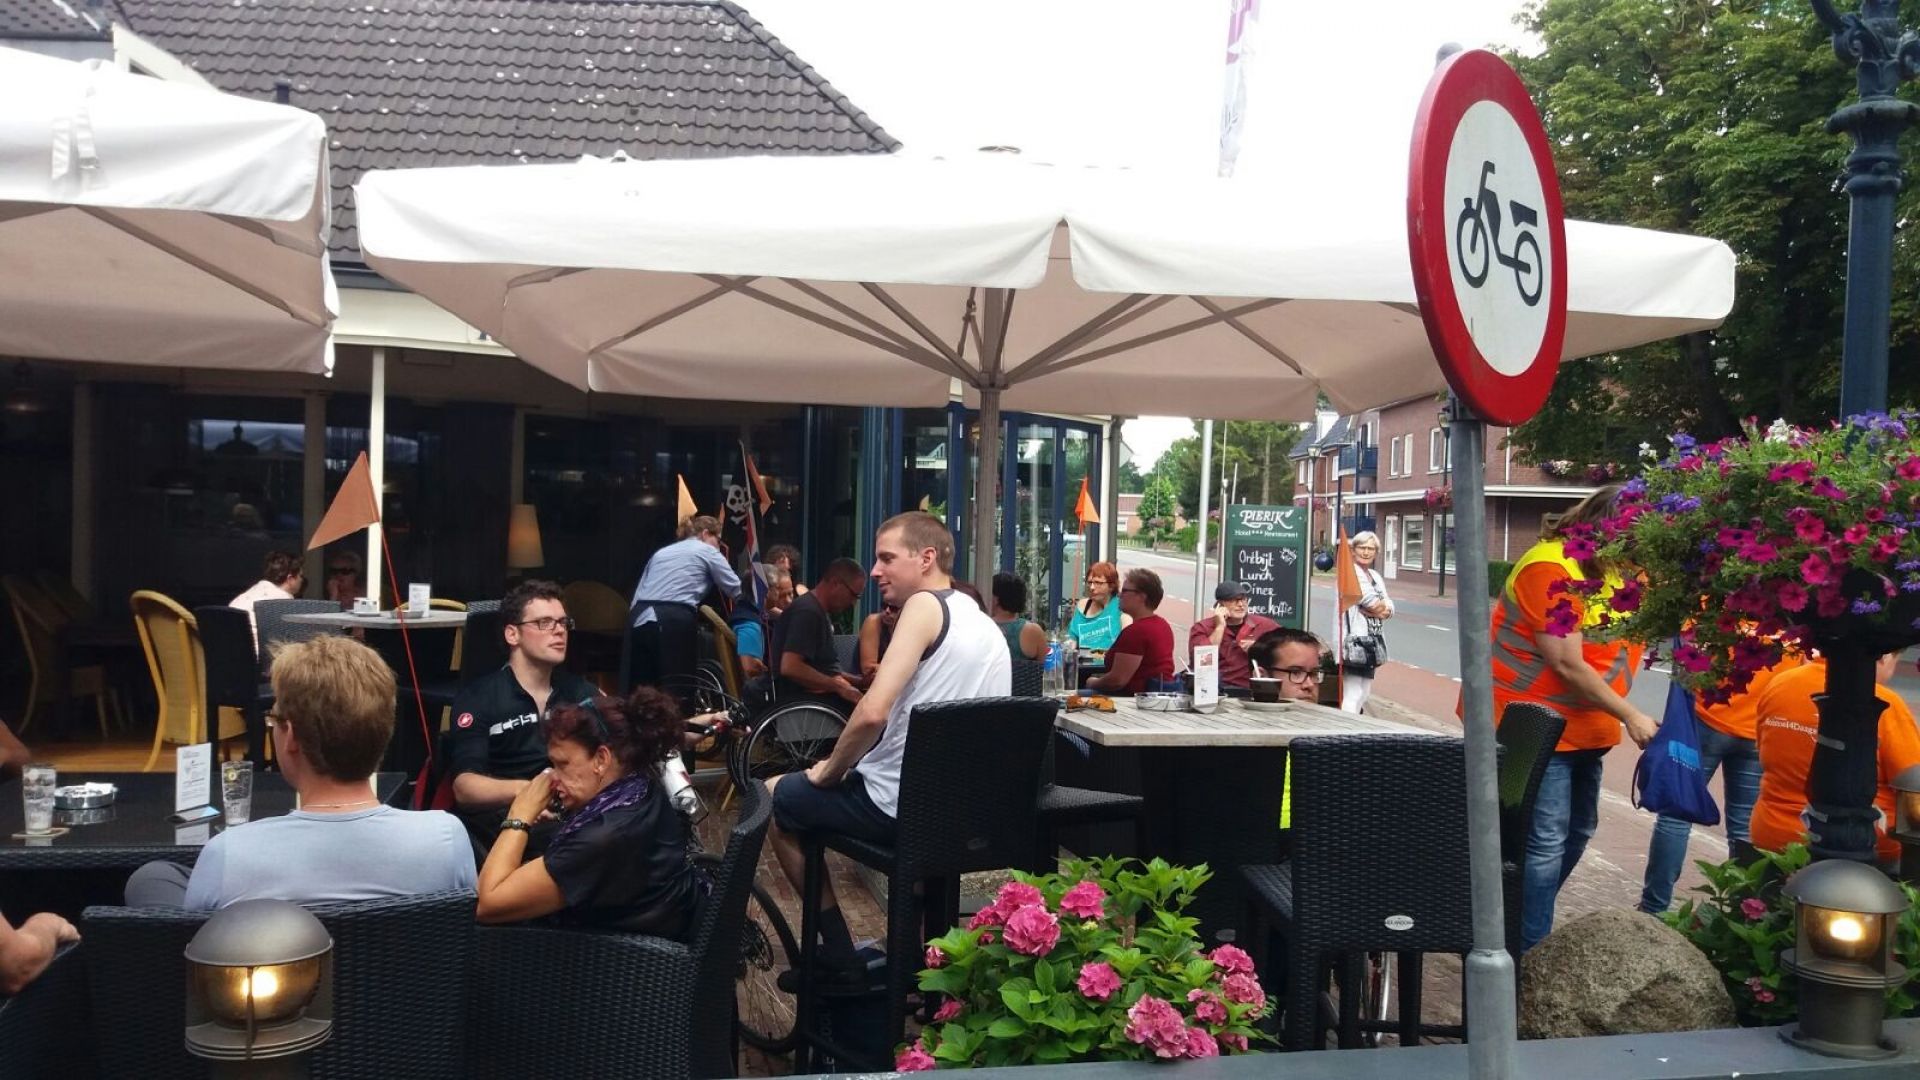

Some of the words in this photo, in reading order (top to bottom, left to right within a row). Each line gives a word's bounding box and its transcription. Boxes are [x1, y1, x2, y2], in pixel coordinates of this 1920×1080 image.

[1239, 509, 1293, 530] PIERIK
[1239, 549, 1274, 572] Ontbijt
[1240, 567, 1275, 582] Lunch
[1240, 581, 1277, 596] Diner
[1267, 596, 1293, 617] koffie
